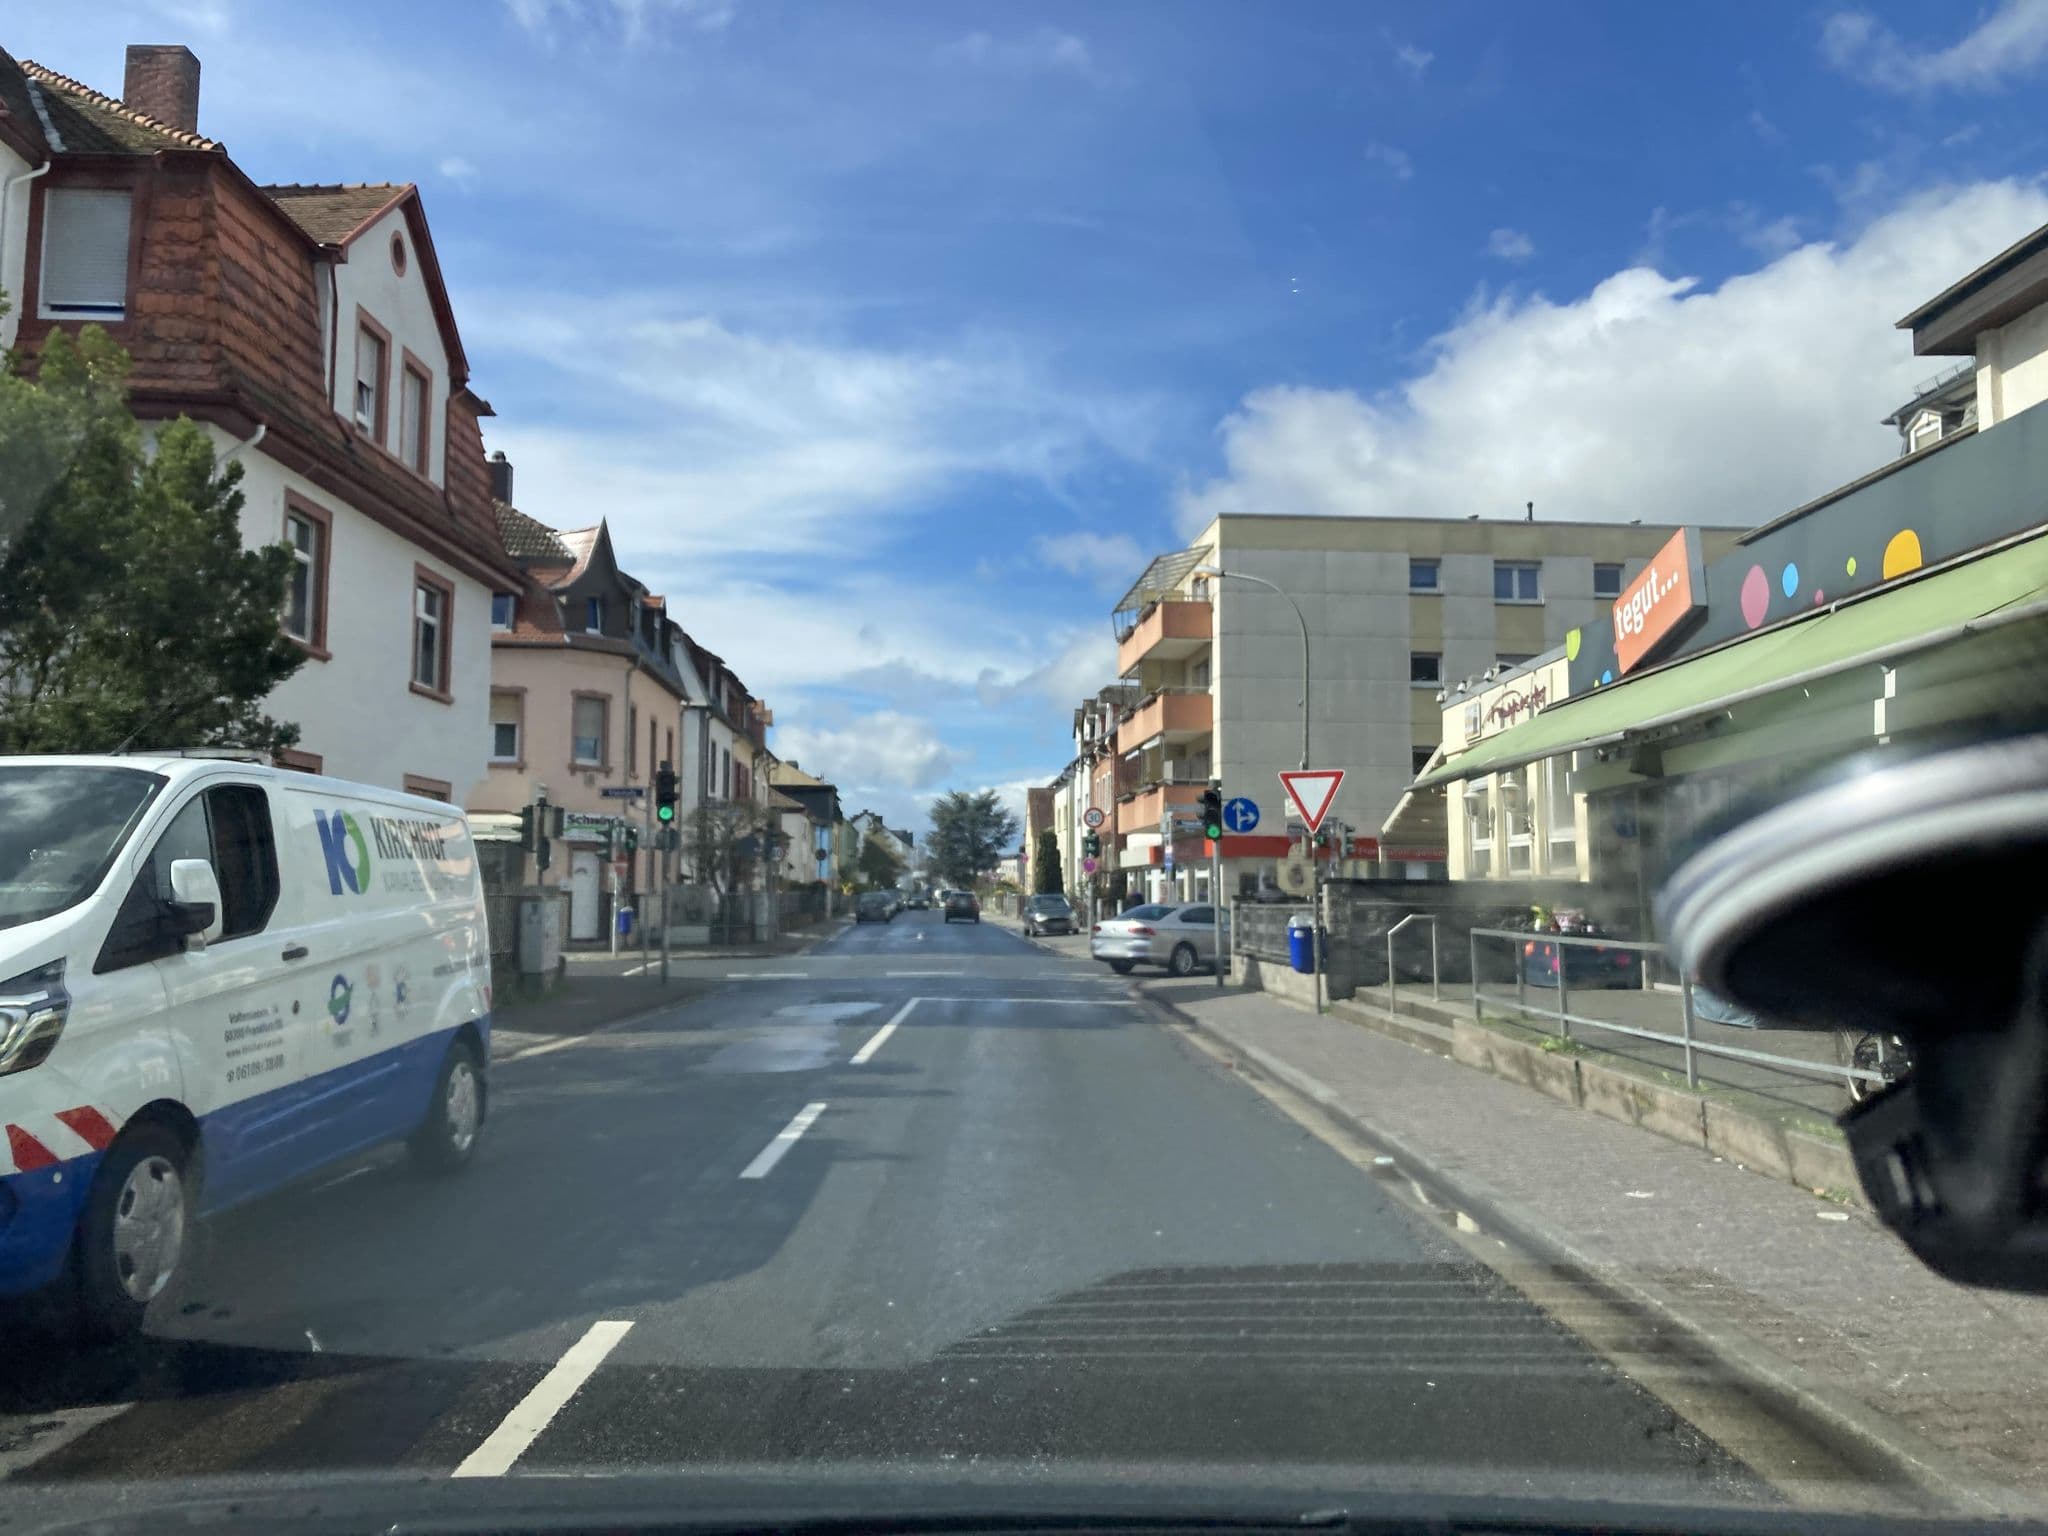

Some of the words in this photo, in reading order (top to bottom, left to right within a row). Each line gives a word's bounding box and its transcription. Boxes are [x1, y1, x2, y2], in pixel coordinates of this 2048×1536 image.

[1615, 566, 1679, 640] tegut...
[369, 816, 447, 861] KIRCHHOF
[1087, 812, 1101, 824] 30
